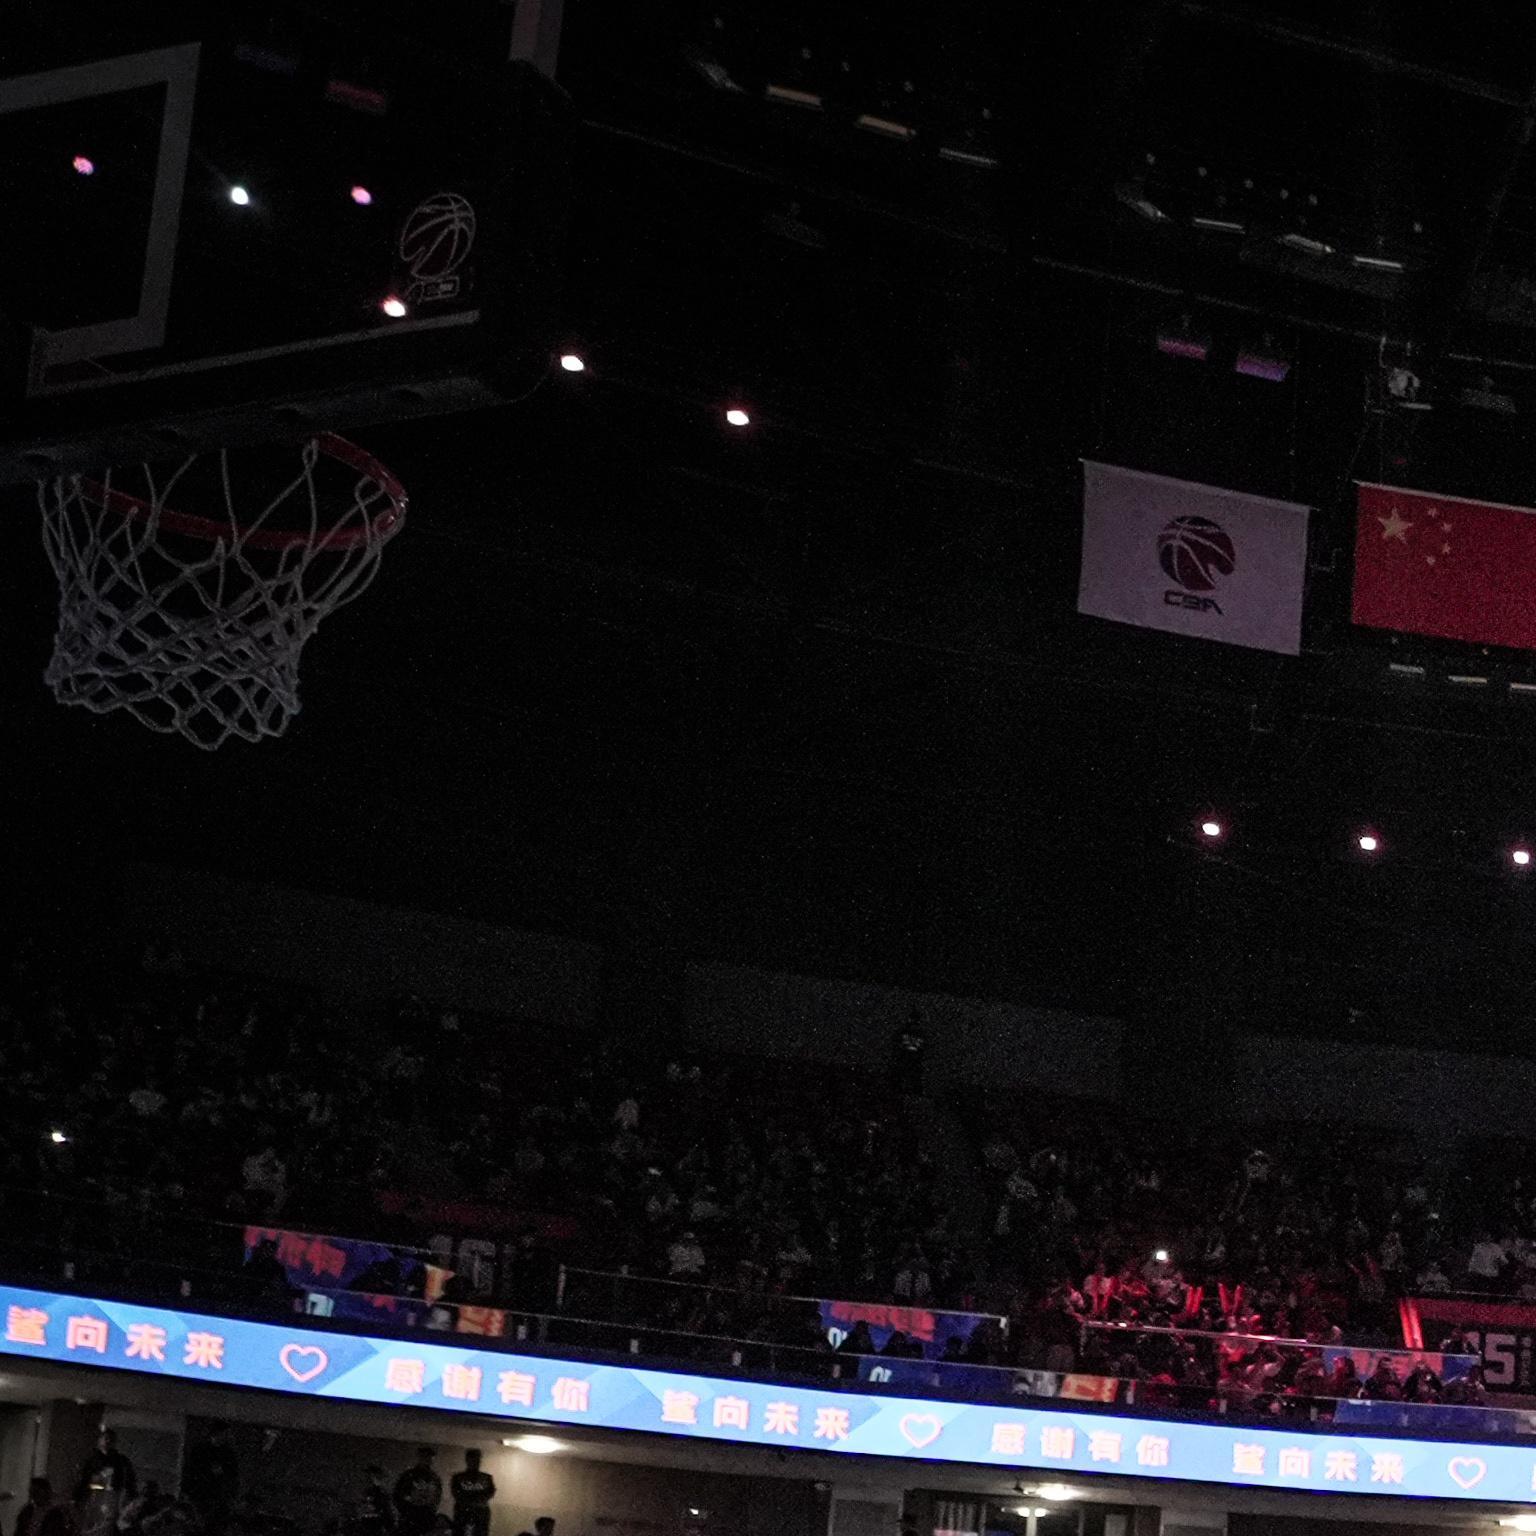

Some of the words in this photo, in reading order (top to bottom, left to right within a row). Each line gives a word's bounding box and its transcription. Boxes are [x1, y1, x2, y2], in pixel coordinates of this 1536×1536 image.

[7, 1305, 226, 1370] 鲨向未来
[386, 1358, 593, 1412] 感谢有你
[664, 1391, 853, 1440] 鲨向未来
[991, 1421, 1171, 1467] 感谢有你
